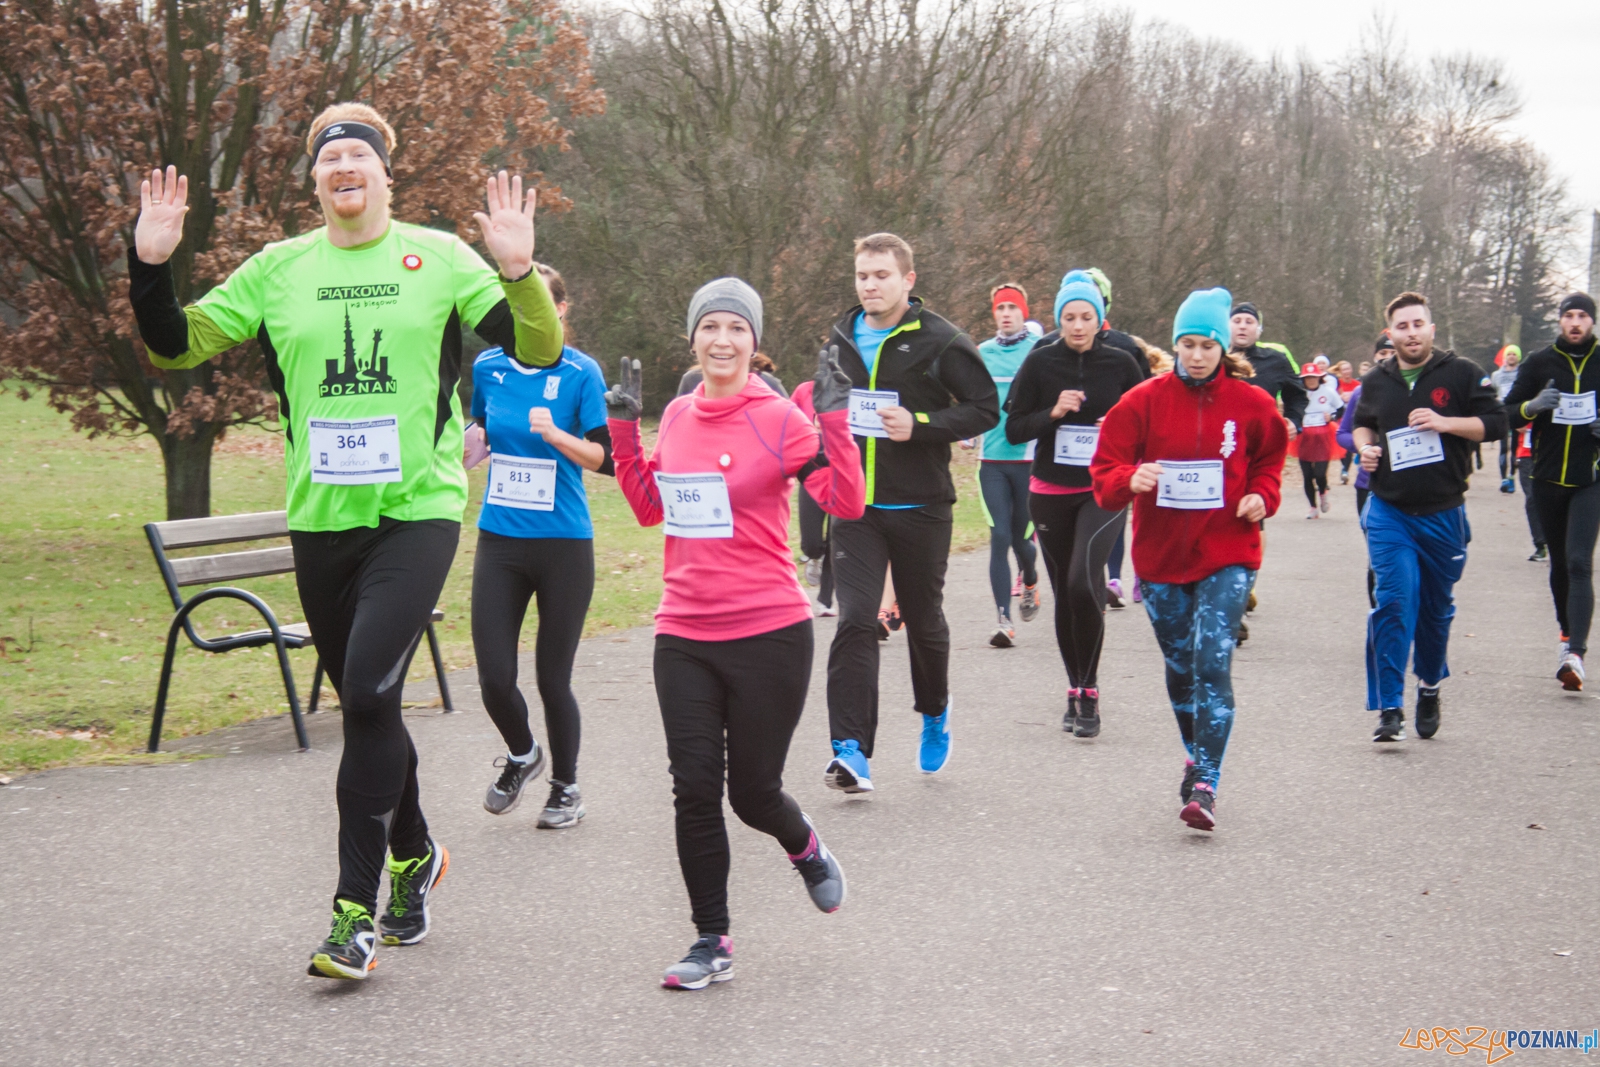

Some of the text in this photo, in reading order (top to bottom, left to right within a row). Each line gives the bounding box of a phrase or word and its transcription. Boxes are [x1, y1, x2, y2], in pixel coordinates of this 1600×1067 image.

[318, 284, 399, 300] PIĄTKOWO
[350, 299, 398, 310] na biegowo
[320, 380, 397, 396] POZNAŃ
[860, 400, 877, 411] 644
[336, 434, 367, 449] 364
[1075, 435, 1094, 444] 400
[1404, 436, 1422, 447] 241
[509, 470, 531, 483] 813
[1177, 472, 1200, 483] 402
[675, 488, 701, 503] 366
